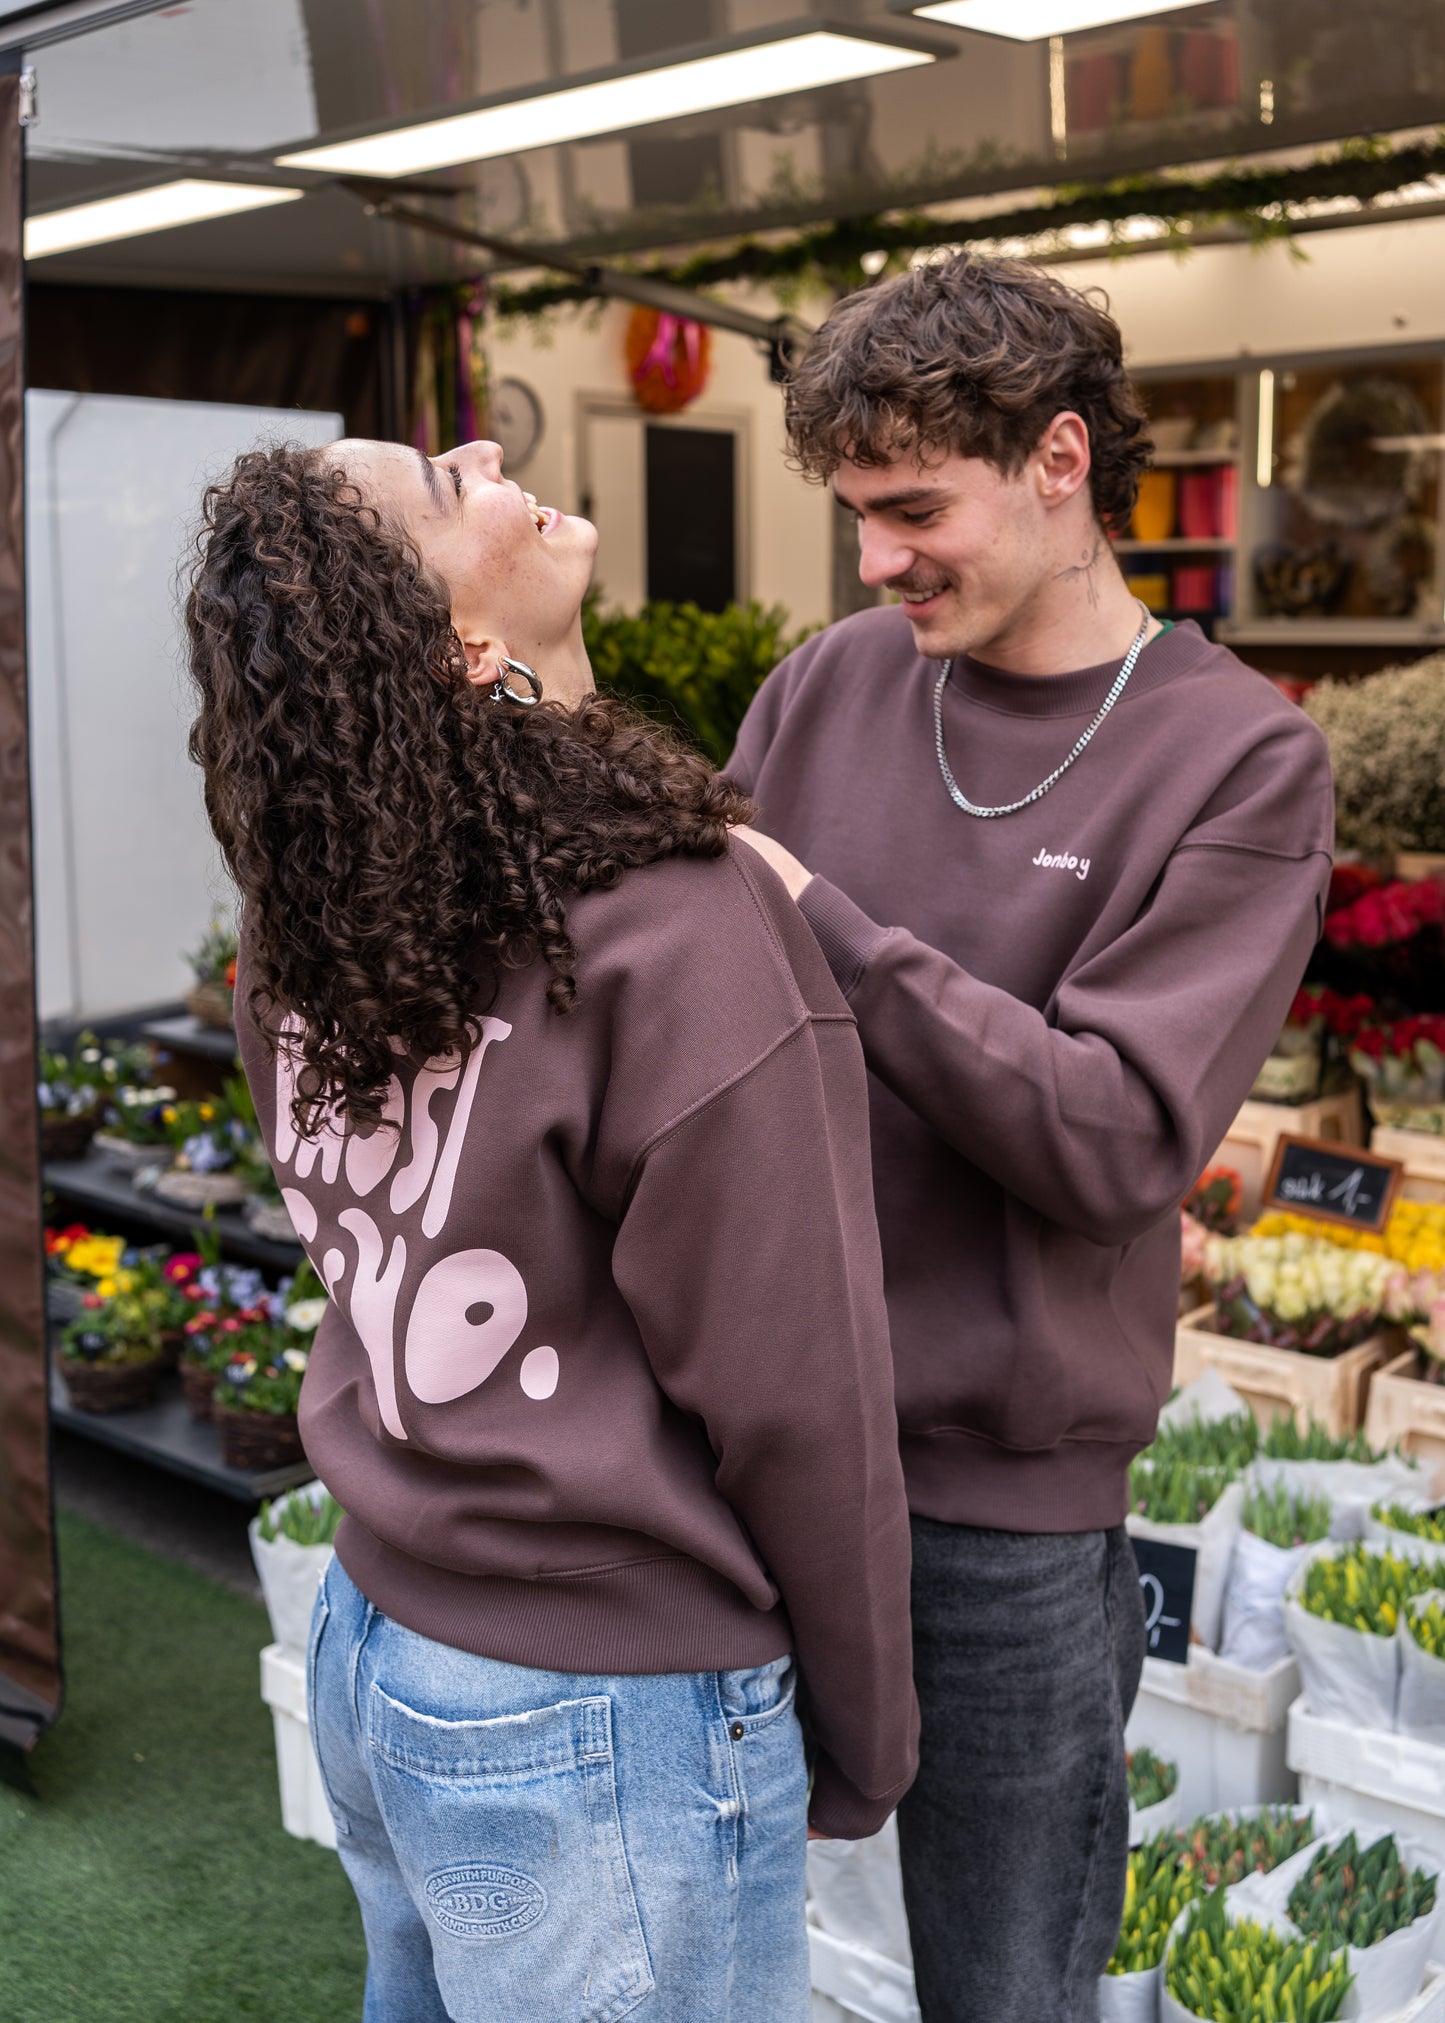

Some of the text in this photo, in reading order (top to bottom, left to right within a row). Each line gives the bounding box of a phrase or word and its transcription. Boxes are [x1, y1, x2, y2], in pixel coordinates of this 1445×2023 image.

[1032, 848, 1090, 880] Jonboy
[449, 1870, 479, 1884] WITH
[481, 1871, 534, 1892] PURPOSE
[453, 1893, 508, 1912] BDG
[439, 1907, 539, 1935] HANDLE WITH CARE
